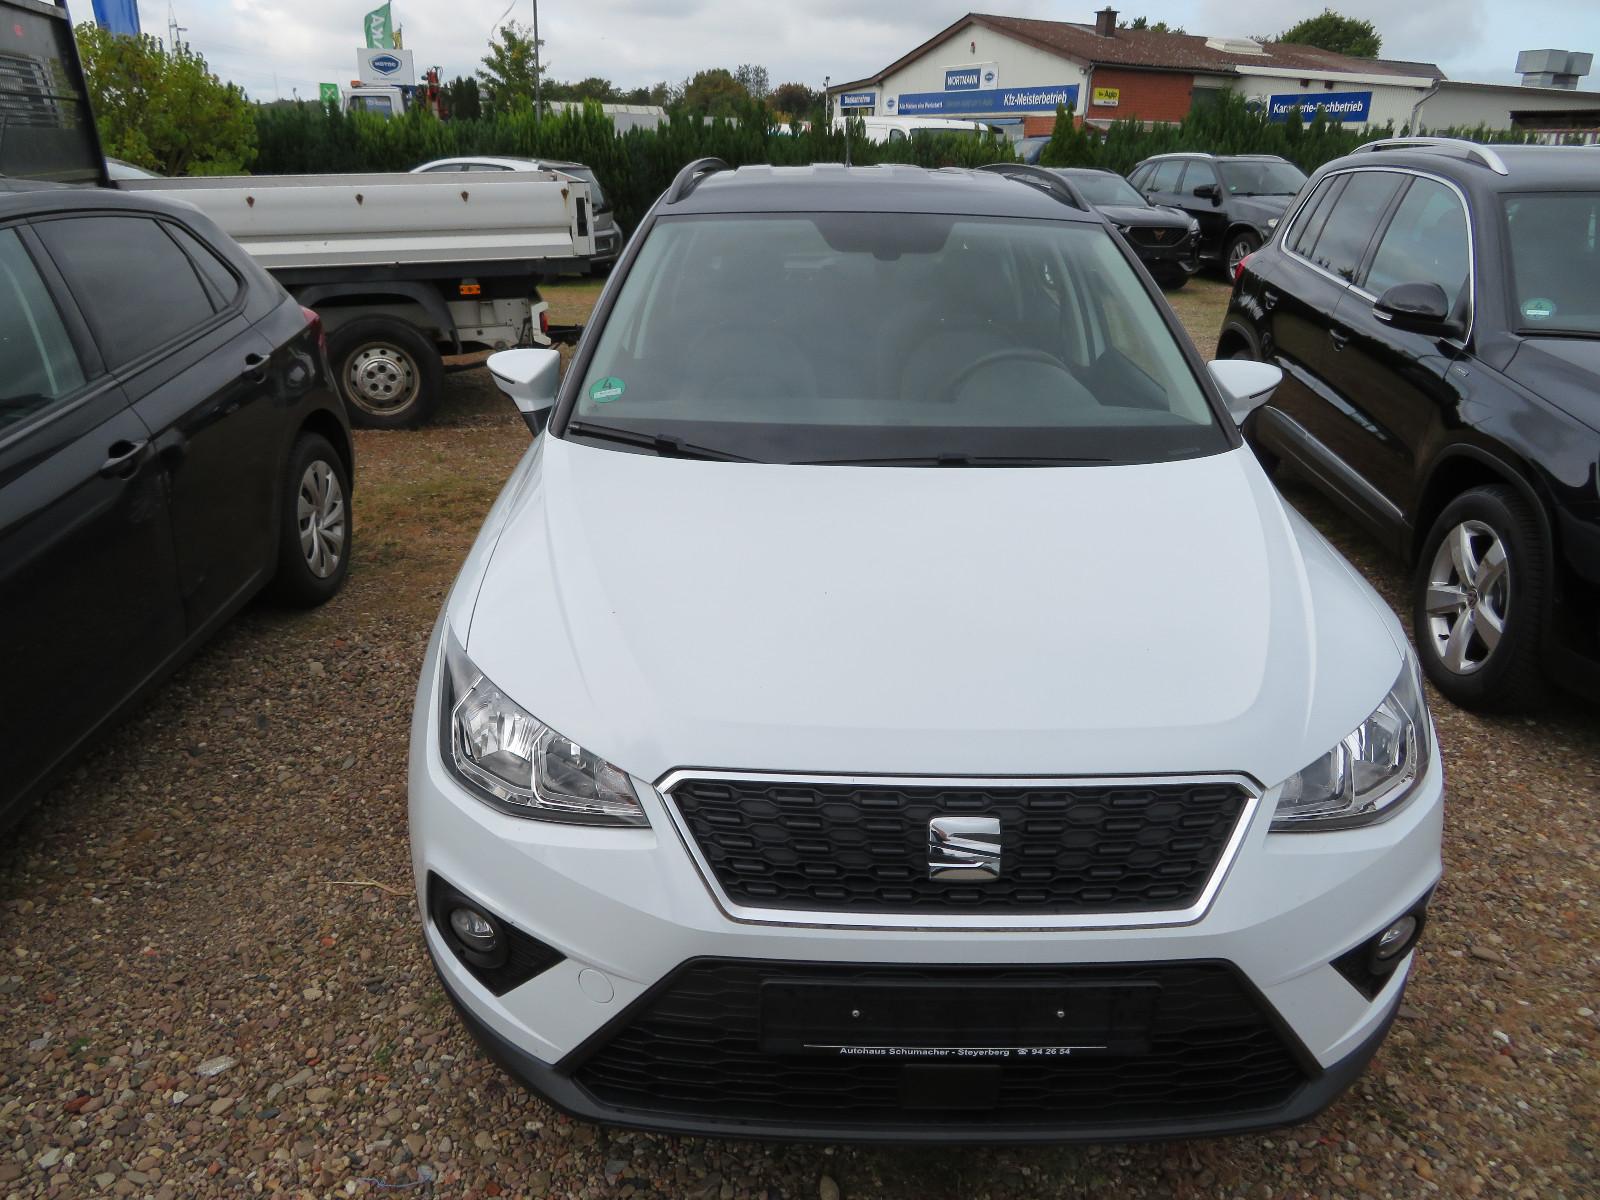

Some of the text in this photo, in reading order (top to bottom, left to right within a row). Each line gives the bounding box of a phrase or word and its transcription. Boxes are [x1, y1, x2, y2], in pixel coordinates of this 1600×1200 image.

[1003, 91, 1067, 106] Kfz-Meisterbetrieb
[840, 1047, 886, 1055] Autohaus
[889, 1048, 950, 1056] Schumacher
